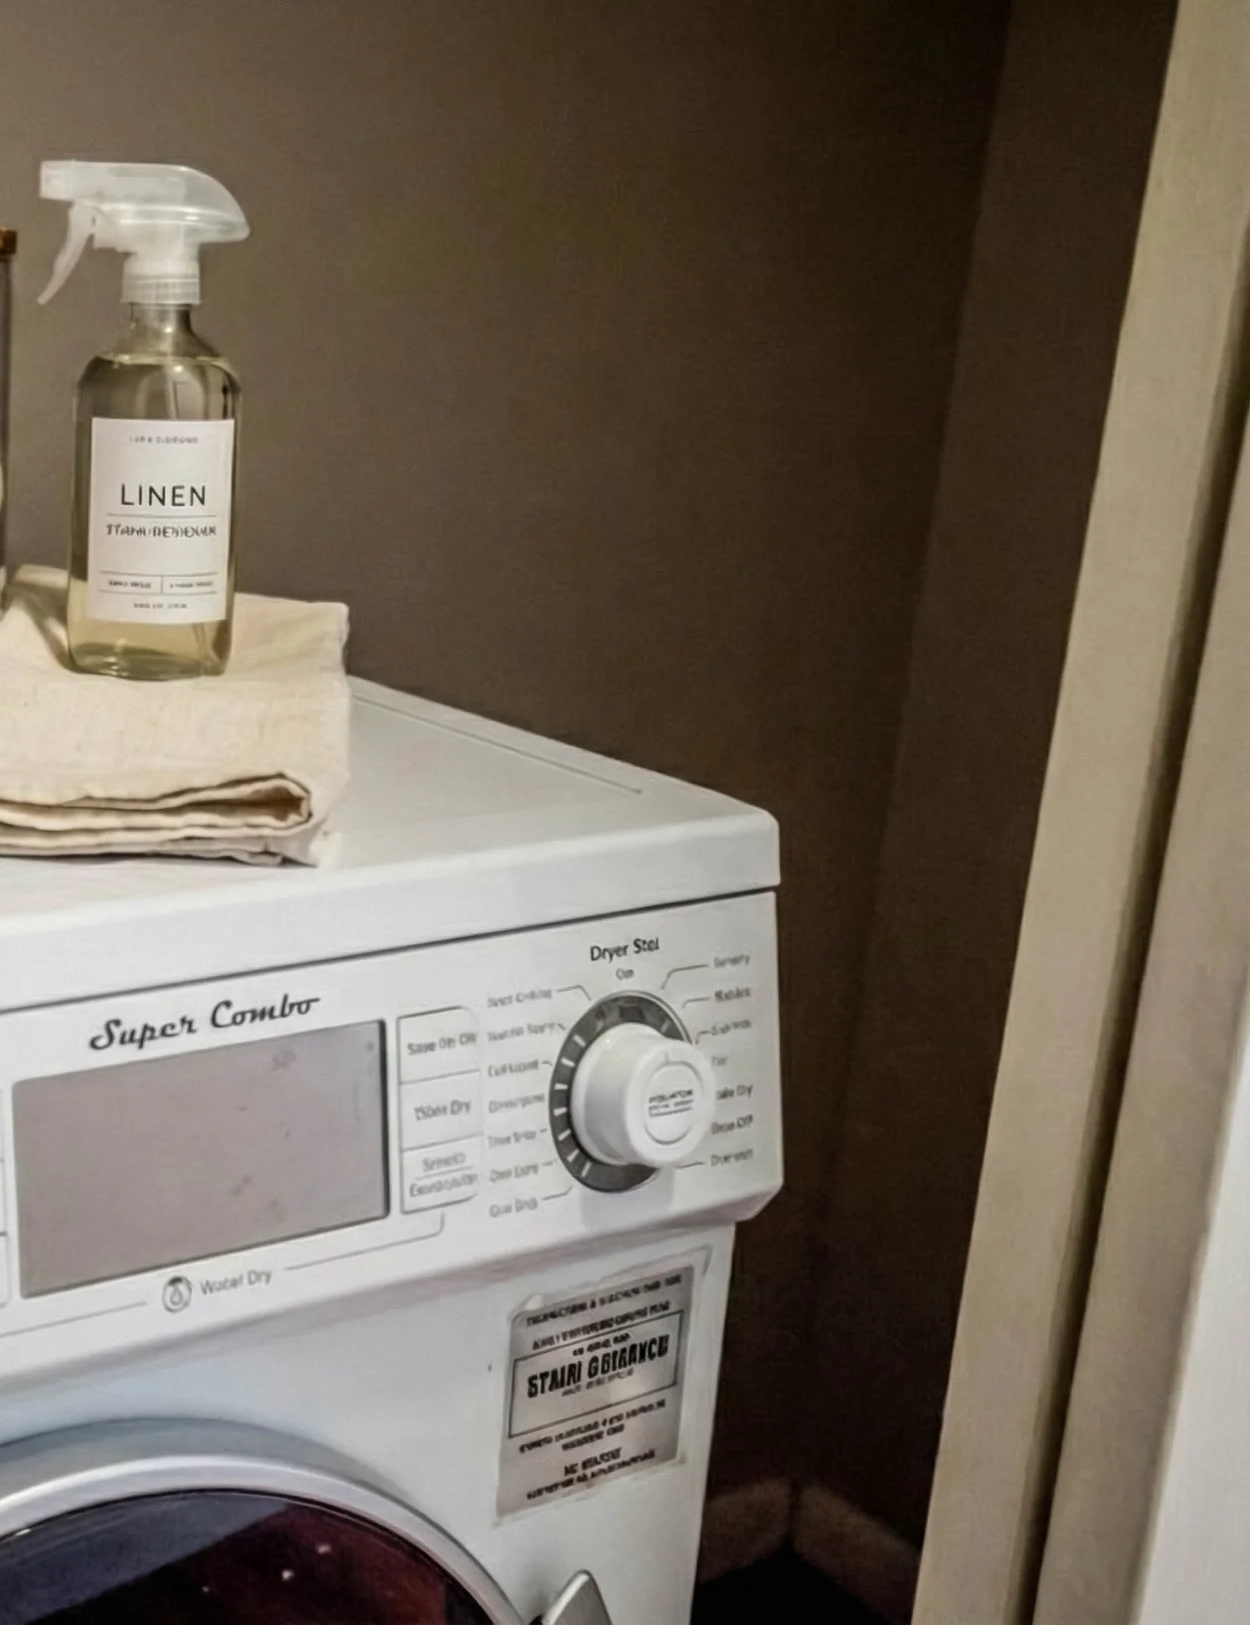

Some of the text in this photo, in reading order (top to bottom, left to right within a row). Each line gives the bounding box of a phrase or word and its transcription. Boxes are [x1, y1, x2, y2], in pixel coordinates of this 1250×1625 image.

[120, 483, 206, 507] LINEN
[590, 943, 629, 963] Dryer
[90, 994, 321, 1051] Super Combo
[247, 1270, 272, 1286] Dry
